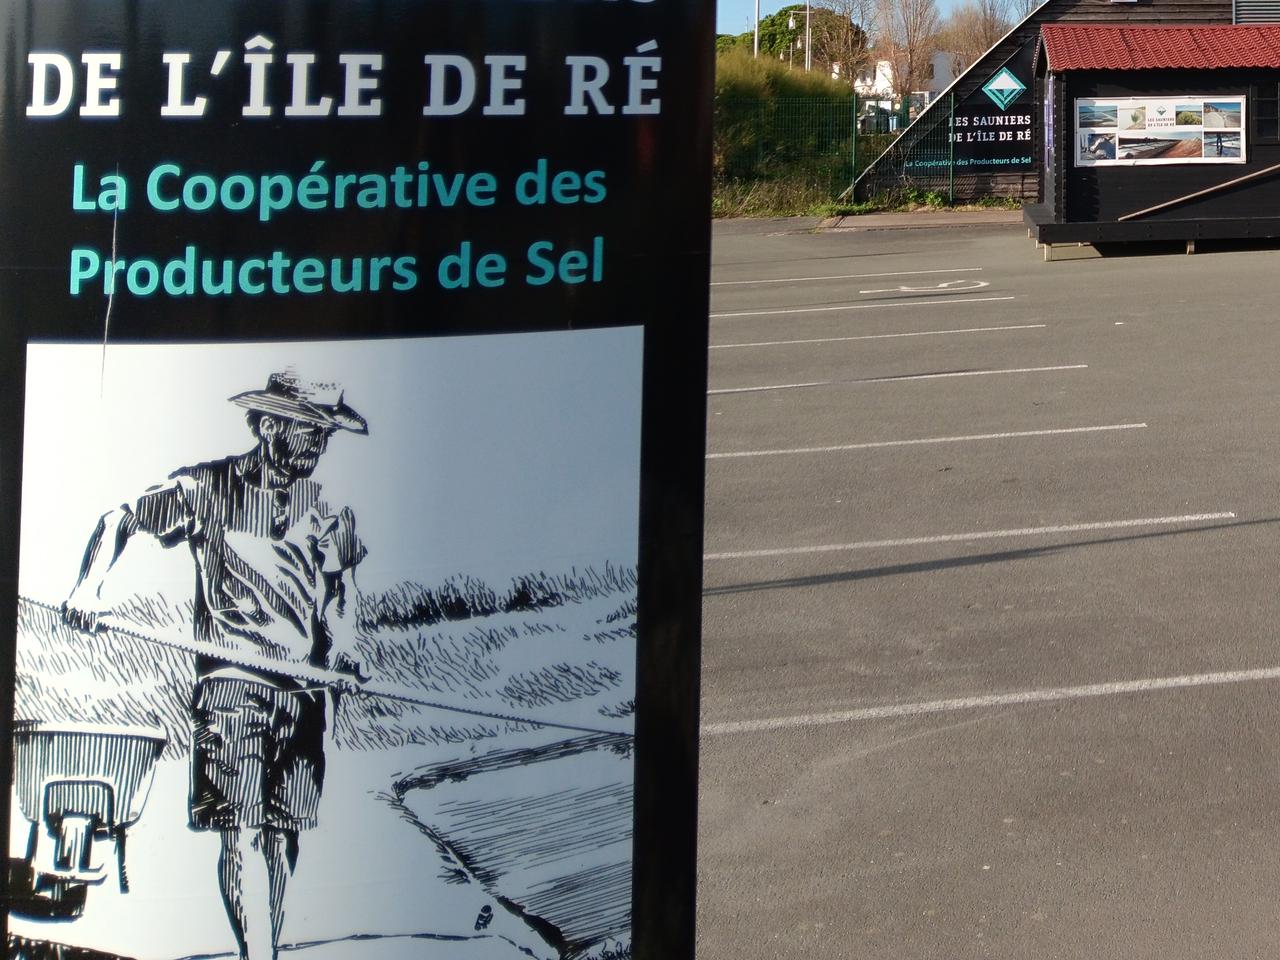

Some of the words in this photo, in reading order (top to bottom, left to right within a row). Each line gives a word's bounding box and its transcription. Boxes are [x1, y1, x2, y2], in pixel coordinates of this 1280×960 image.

[25, 51, 121, 117] DE
[160, 34, 383, 117] L'ÎLE
[422, 53, 527, 116] DE
[563, 38, 662, 115] RÉ
[966, 130, 996, 142] L'ÎLE
[998, 131, 1012, 142] DE
[1016, 128, 1031, 141] RÉ
[973, 115, 1031, 126] SAUNIERS
[956, 158, 969, 166] des
[969, 157, 1010, 166] Producteurs
[1011, 156, 1020, 164] de
[1020, 156, 1032, 164] Sel
[72, 164, 127, 211] La
[146, 160, 498, 222] Coopérative
[514, 158, 608, 206] des
[69, 246, 418, 296] Producteurs
[437, 241, 507, 289] de
[525, 236, 604, 286] Sel
